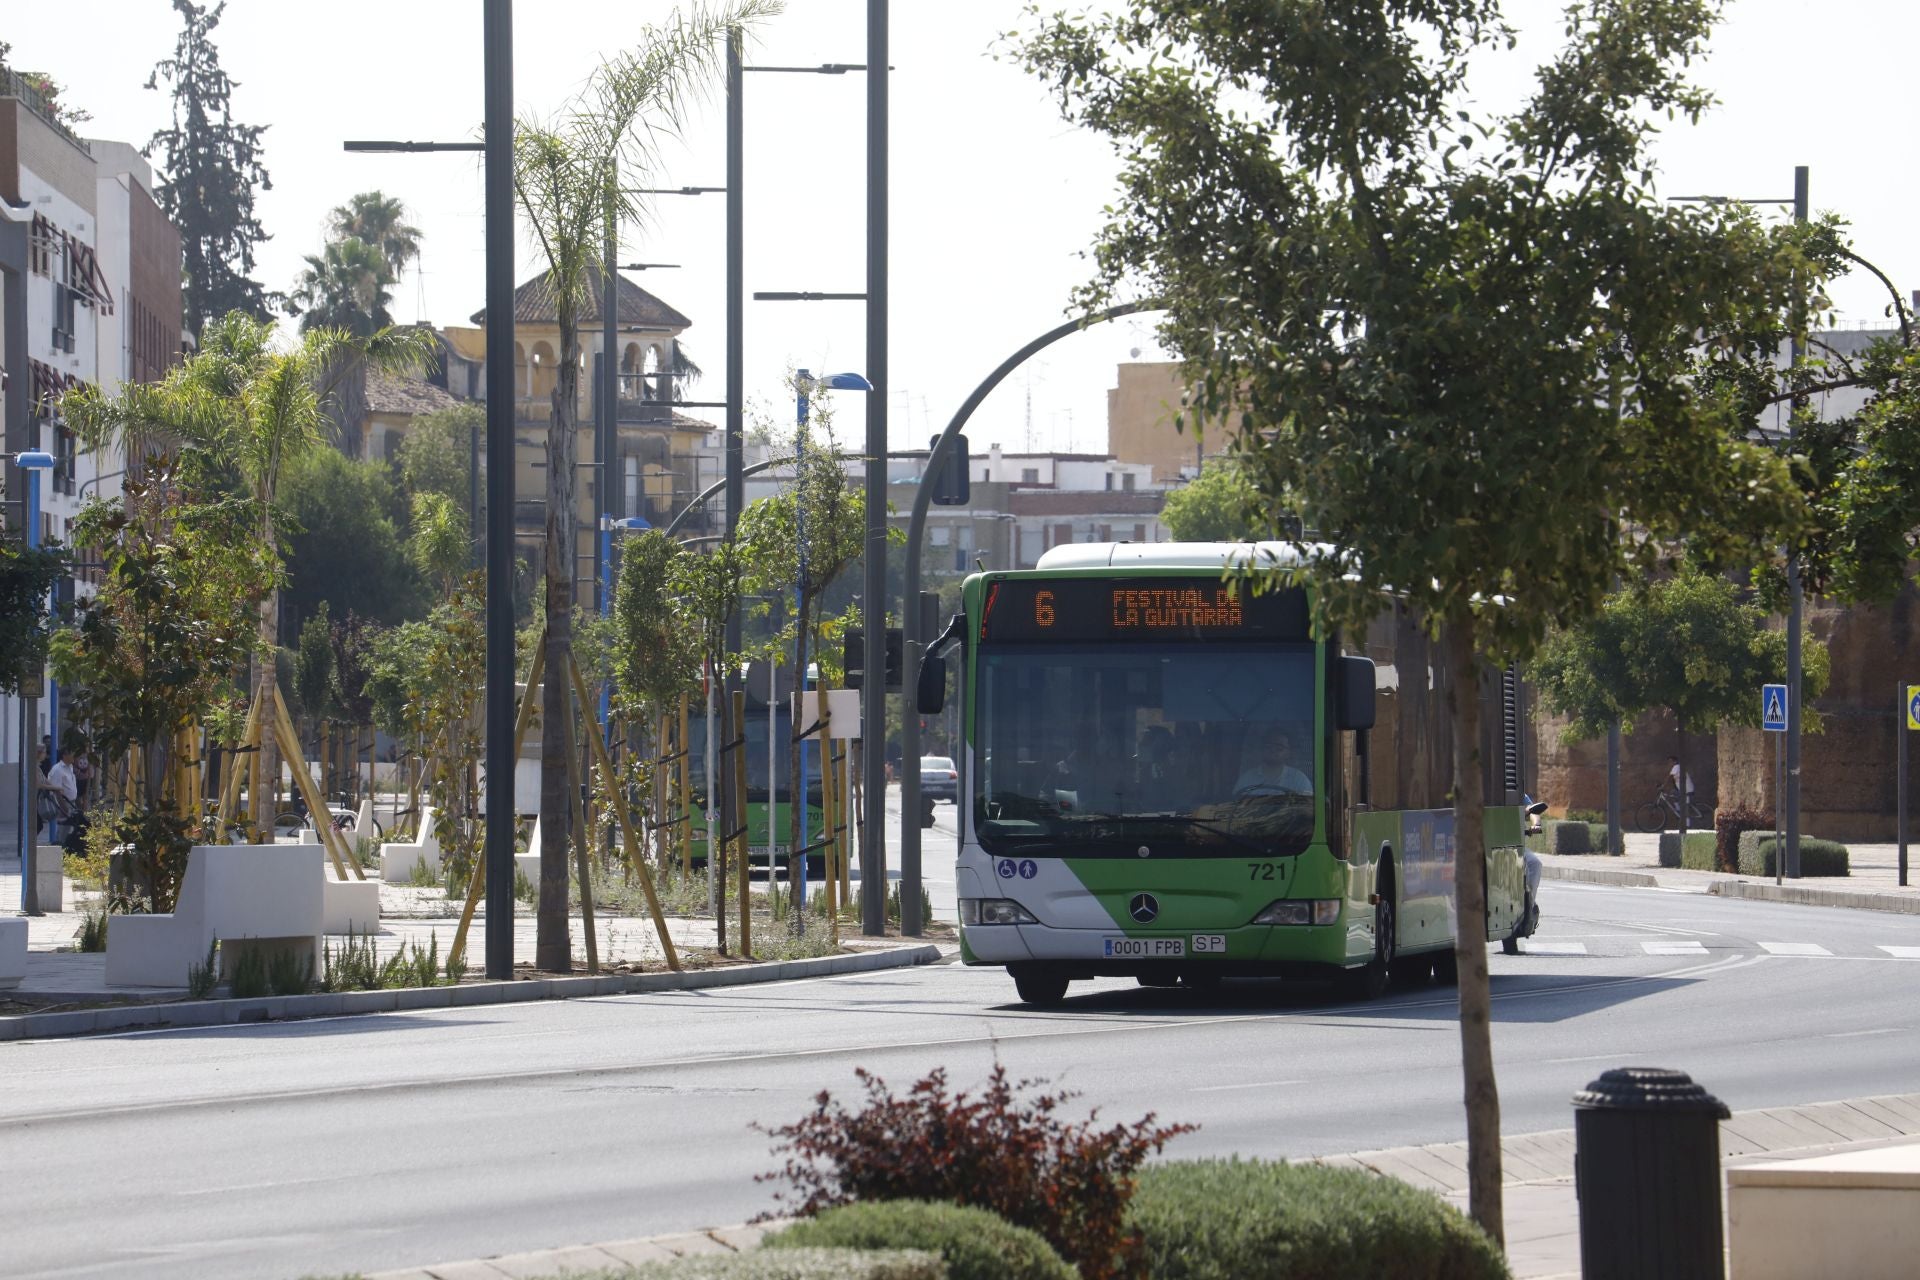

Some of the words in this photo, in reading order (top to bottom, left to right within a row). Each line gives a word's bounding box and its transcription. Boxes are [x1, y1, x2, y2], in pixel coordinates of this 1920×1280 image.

[1113, 590, 1210, 607] FESTIVAL
[1036, 591, 1055, 626] 6
[1113, 608, 1139, 626] LA
[1145, 608, 1242, 626] GUITARRA
[1247, 863, 1286, 881] 721
[1114, 941, 1149, 954] 0001
[1155, 941, 1182, 954] FPB
